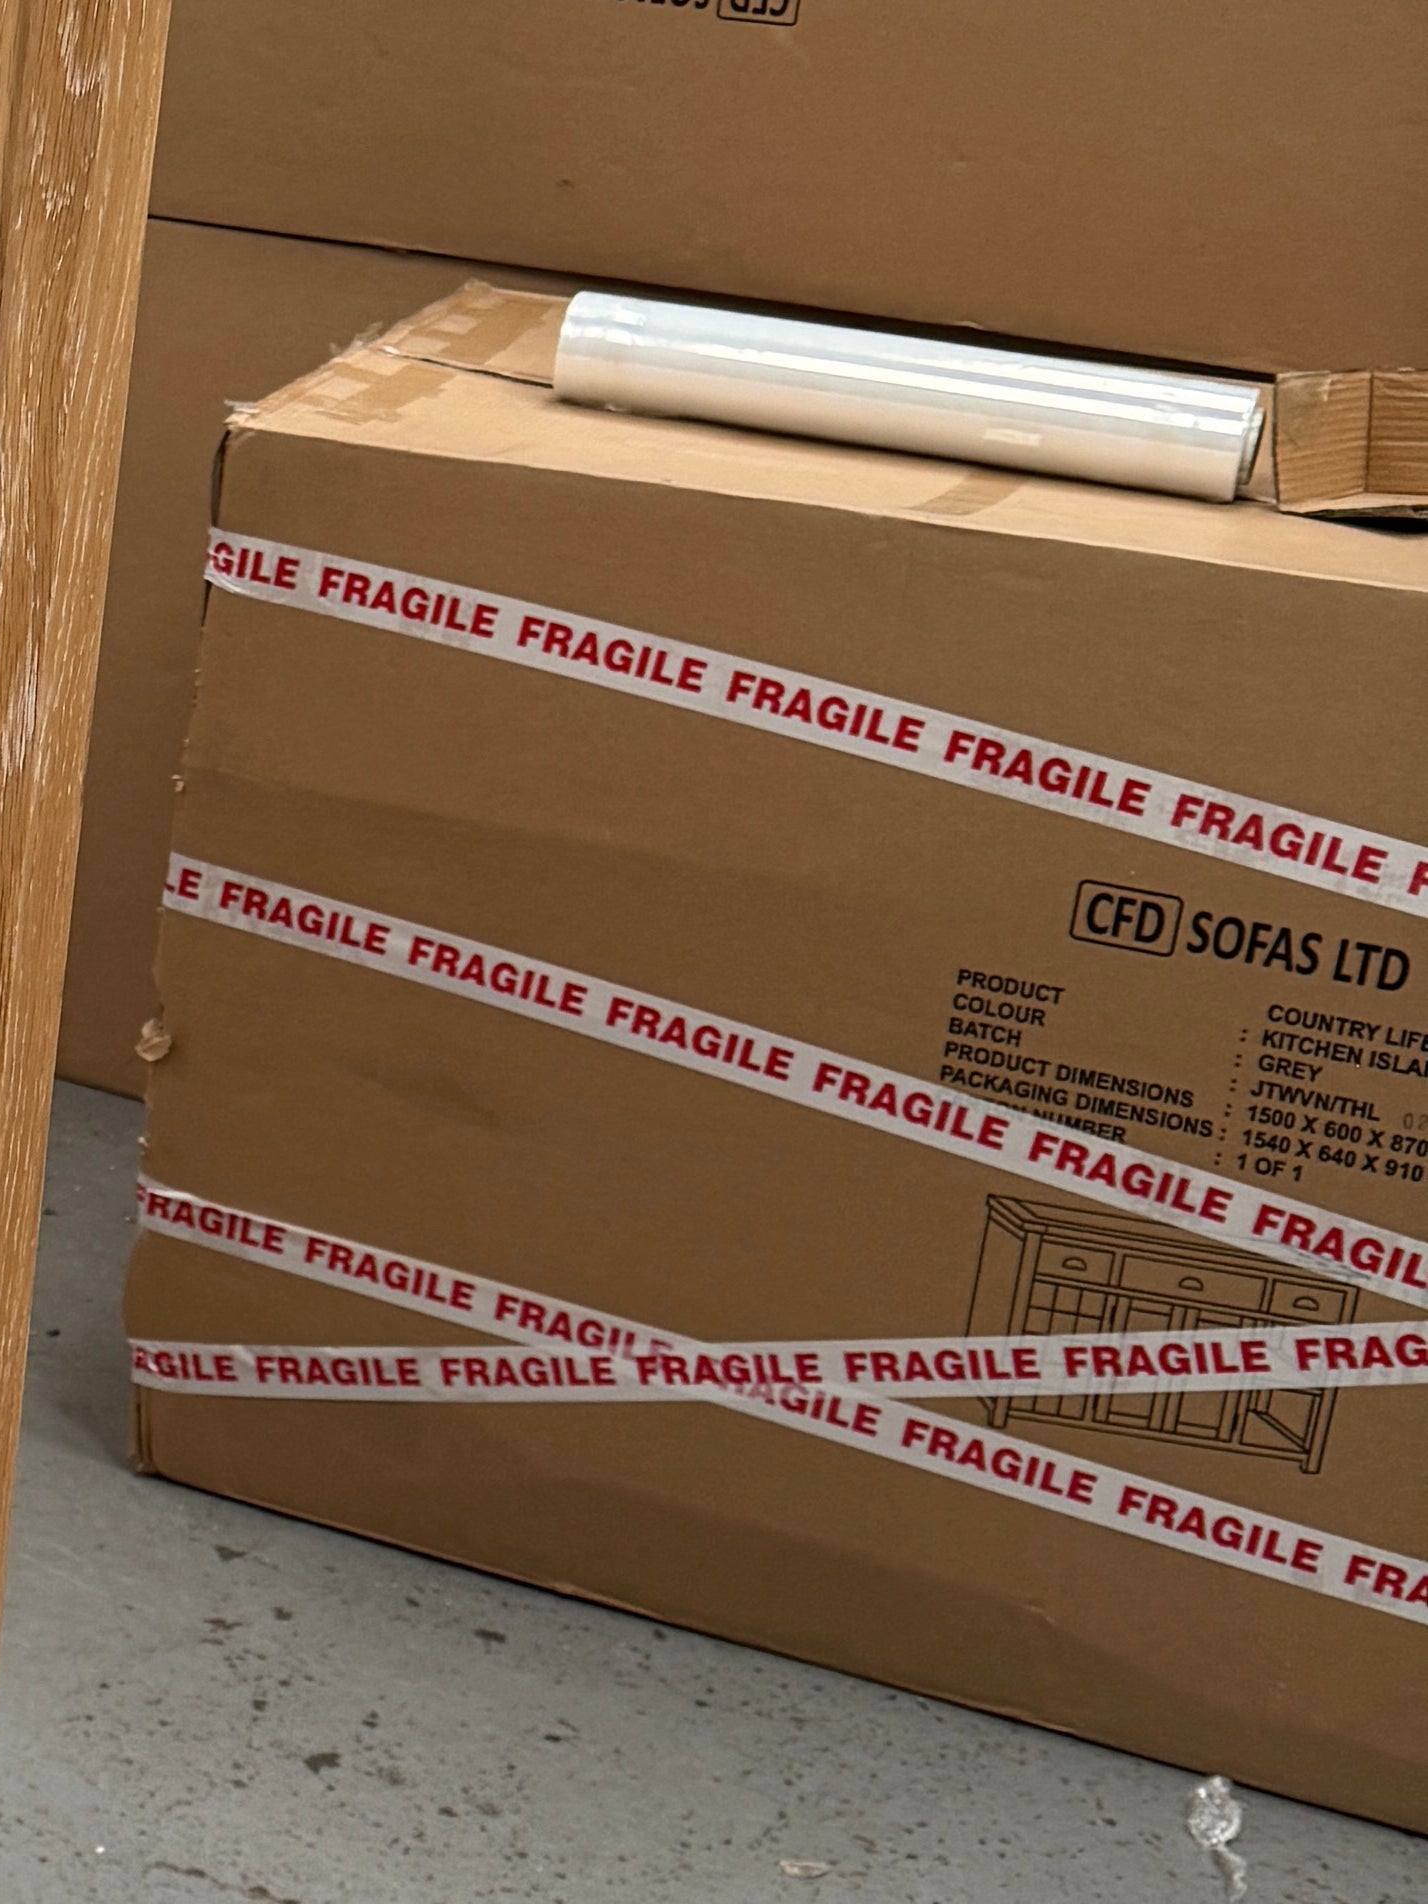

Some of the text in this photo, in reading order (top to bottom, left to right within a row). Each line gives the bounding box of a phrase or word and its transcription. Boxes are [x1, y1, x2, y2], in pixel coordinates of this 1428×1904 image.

[207, 541, 300, 591] GILE
[318, 567, 500, 639] FRAGILE
[517, 616, 709, 694] FRAGILE
[726, 670, 926, 753] FRAGILE
[944, 731, 1152, 817] FRAGILE
[1171, 794, 1388, 884] FRAGILE
[1086, 892, 1410, 992] CFD SOFAS LTD
[219, 882, 391, 956] FRAGILE
[408, 937, 588, 1016] FRAGILE
[605, 998, 794, 1081] FRAGILE
[813, 1063, 1007, 1150] FRAGILE
[1028, 1131, 1234, 1224] FRAGILE
[949, 1017, 1021, 1047] BATCH
[1251, 1081, 1381, 1121] JTWVN/THL
[953, 993, 1323, 1083] COLOUR GREY
[957, 969, 1428, 1078] PRODUCT KITCHEN ISLA
[1268, 1004, 1381, 1041] COUNTRY
[940, 1065, 1067, 1106] PACKAGING
[1076, 1092, 1213, 1137] DIMENSIONS
[1242, 1130, 1291, 1153] 1540
[1295, 1139, 1312, 1159] X
[1318, 1145, 1356, 1168] 640
[1362, 1154, 1379, 1173] X
[1385, 1159, 1424, 1182] 910
[944, 1041, 1428, 1157] PRODUCT DIMENSIONS 1500 X 600 X 870
[1237, 1154, 1247, 1170] 1
[1255, 1158, 1286, 1178] OF
[1292, 1165, 1302, 1181] 1
[256, 1356, 421, 1387] FRAGILE
[440, 1356, 617, 1388] FRAGILE
[638, 1353, 823, 1385] FRAGILE
[845, 1348, 1042, 1382] FRAGILE
[1063, 1340, 1272, 1379] FRAGILE
[304, 1236, 476, 1311] FRAGILE
[900, 1419, 1099, 1504] FRAGILE
[1117, 1486, 1324, 1574] FRAGILE
